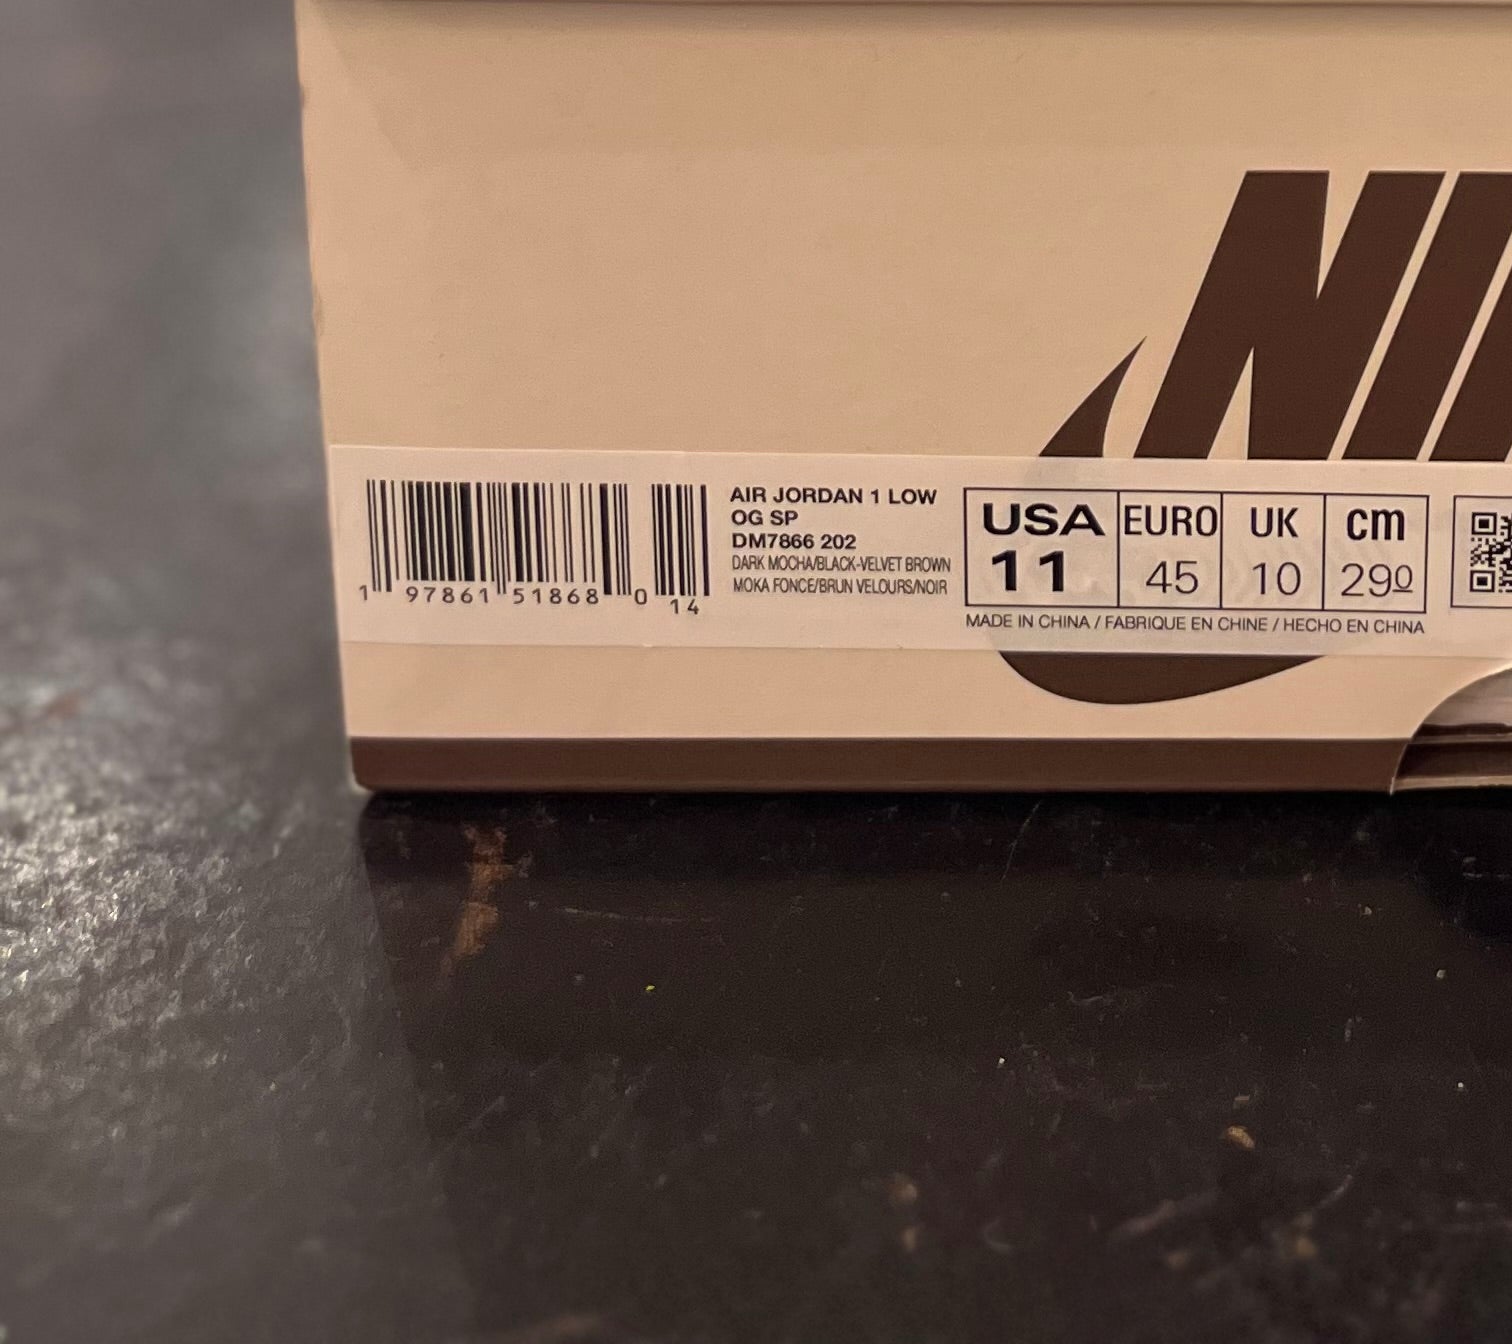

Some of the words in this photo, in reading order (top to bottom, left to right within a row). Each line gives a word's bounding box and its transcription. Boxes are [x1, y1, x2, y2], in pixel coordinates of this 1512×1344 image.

[729, 486, 767, 504] AIR
[772, 486, 863, 504] JORDAN
[870, 488, 879, 505] 1
[888, 488, 938, 505] LOW
[730, 509, 764, 527] OG
[769, 509, 799, 527] SP
[982, 502, 1106, 537] USA
[1124, 504, 1218, 537] EURO
[1250, 506, 1299, 538] UK
[1346, 508, 1405, 541] cm
[731, 532, 815, 550] DM7866
[820, 533, 857, 550] 202
[731, 554, 766, 571] DARK
[767, 554, 903, 573] MOCHA/BLACK-VELVET
[904, 556, 952, 573] BROWN
[991, 549, 1065, 593] 11
[1145, 560, 1199, 595] 45
[1252, 561, 1301, 596] 10
[733, 576, 771, 593] MOKA
[772, 577, 854, 595] FONCE/BRUN
[855, 577, 948, 595] VELOURS/NOIR
[358, 584, 368, 601] 1
[405, 585, 489, 605] 97861
[513, 587, 599, 605] 51868
[633, 588, 648, 606] 0
[669, 598, 700, 616] 14
[965, 613, 1013, 629] MADE
[1018, 614, 1034, 629] IN
[1038, 613, 1091, 630] CHINA
[1093, 615, 1102, 630] /
[1104, 614, 1187, 631] FABRIQUE
[1191, 616, 1213, 631] EN
[1217, 616, 1268, 632] CHINE
[1271, 617, 1280, 633] /
[1283, 617, 1343, 634] HECHO
[1346, 618, 1369, 634] EN
[1373, 619, 1425, 635] CHINA
